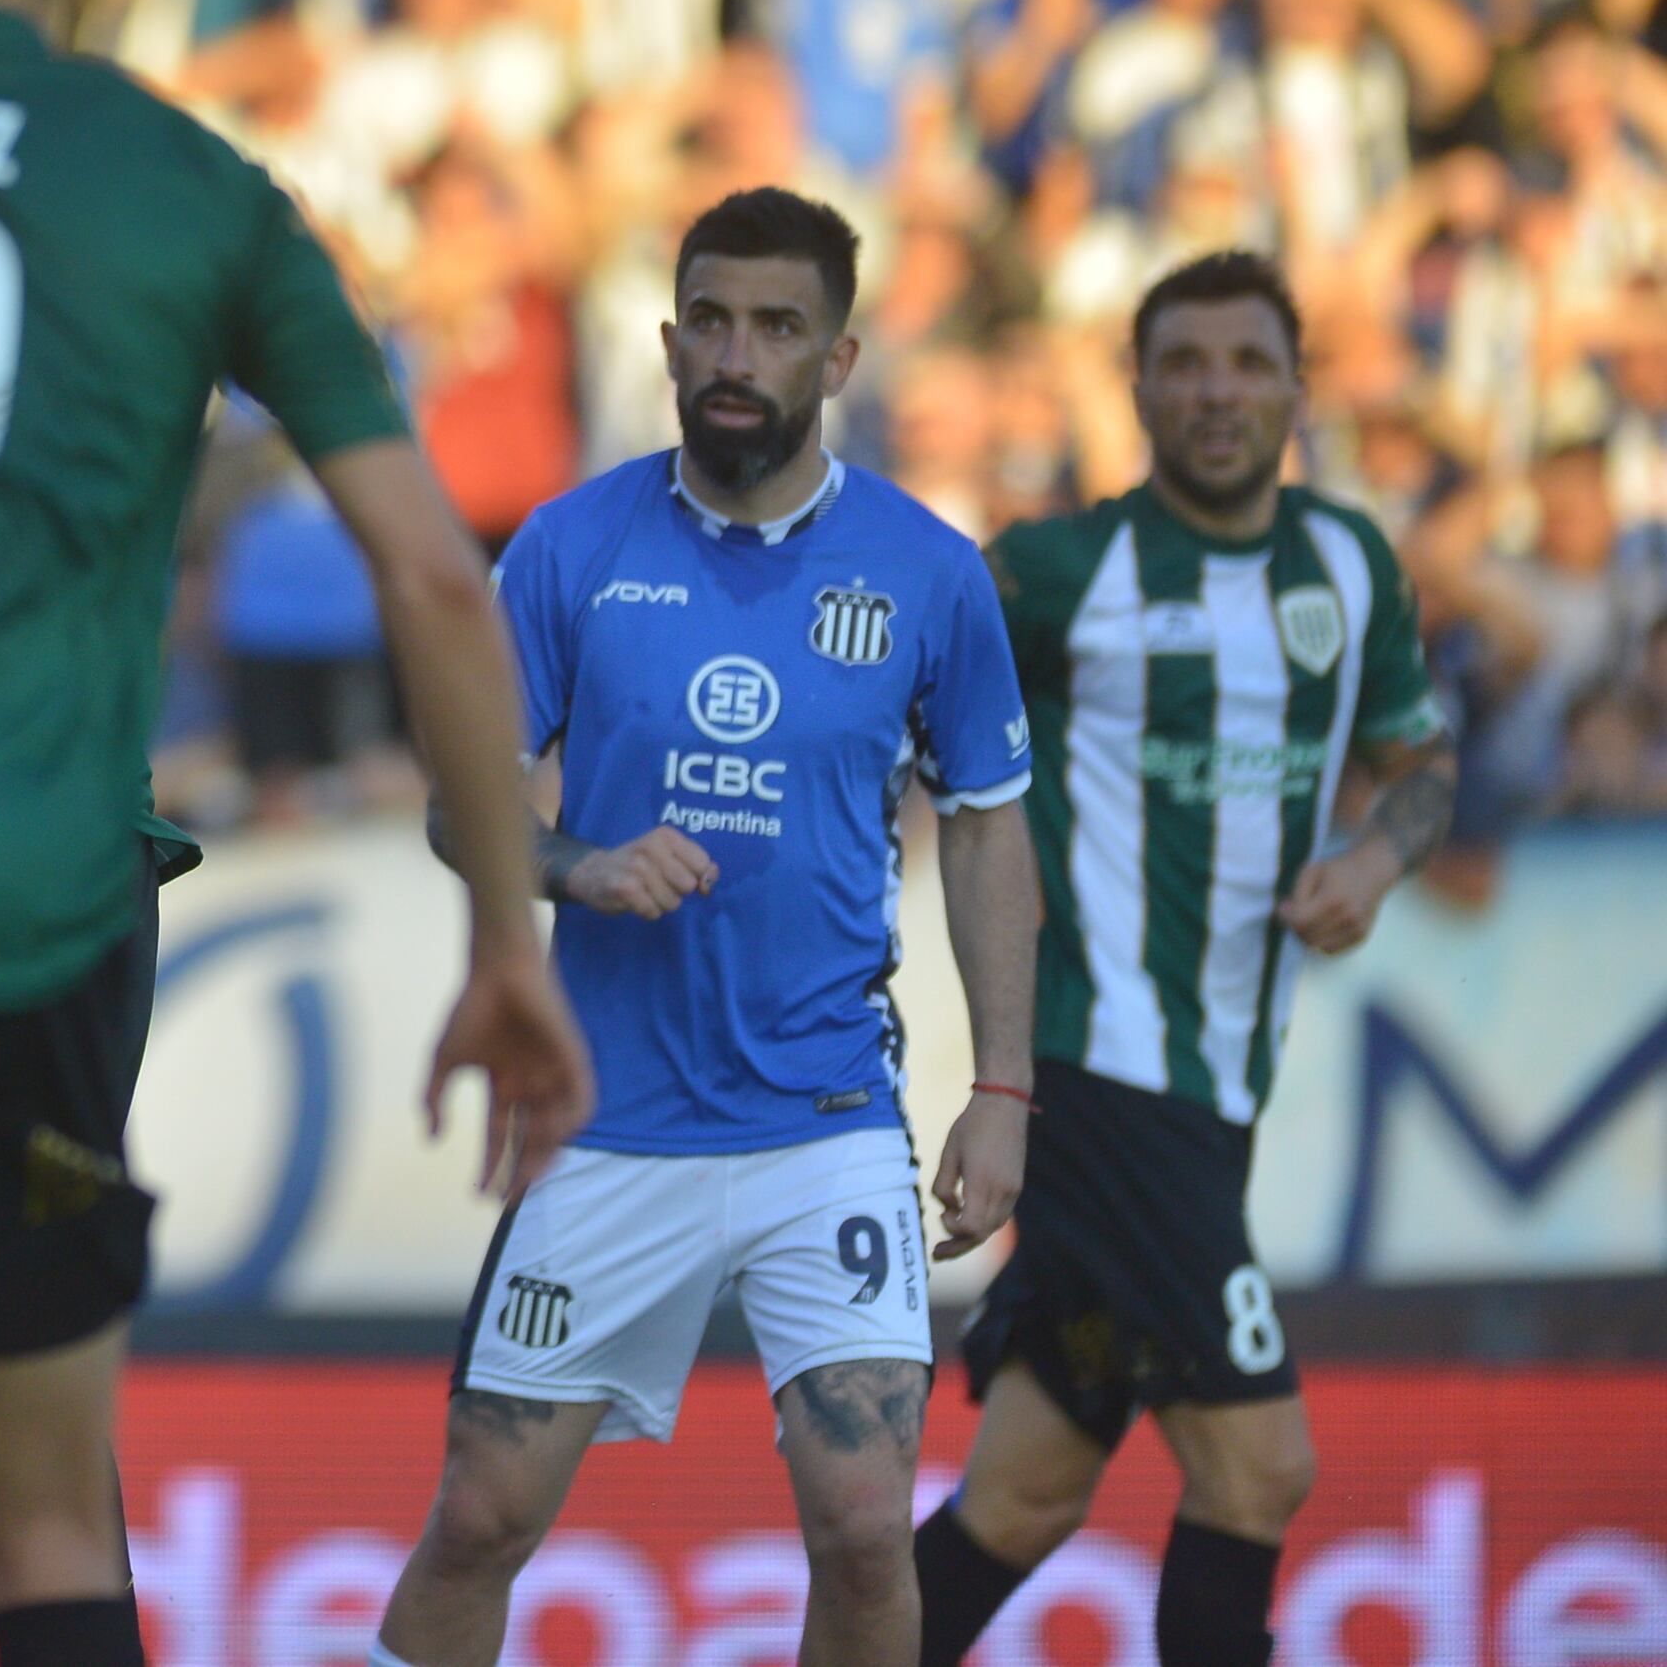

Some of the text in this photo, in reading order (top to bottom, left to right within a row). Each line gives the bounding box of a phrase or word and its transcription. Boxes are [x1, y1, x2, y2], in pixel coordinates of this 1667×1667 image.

[664, 749, 786, 802] ICBC
[660, 800, 781, 837] Argentina
[837, 1215, 888, 1306] 9
[1223, 1262, 1286, 1375] 8
